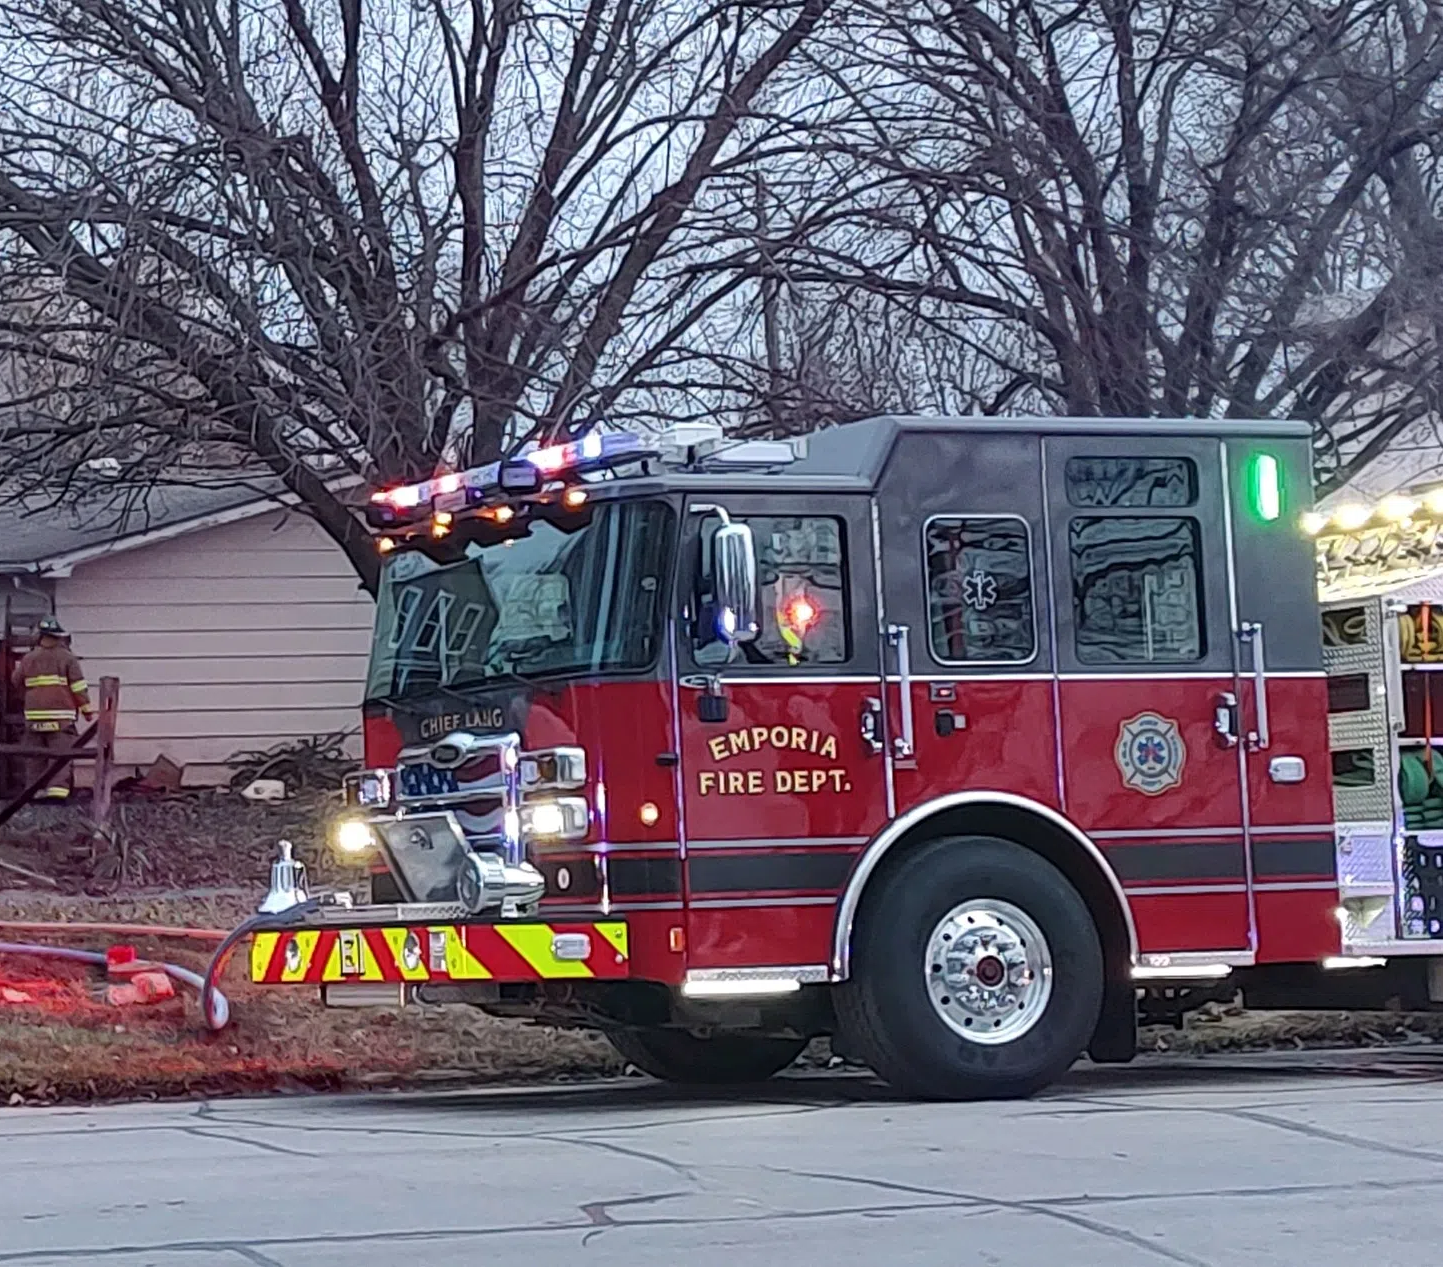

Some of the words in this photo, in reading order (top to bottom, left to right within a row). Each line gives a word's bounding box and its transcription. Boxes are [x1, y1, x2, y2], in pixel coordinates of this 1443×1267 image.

[420, 713, 461, 738] CHIEF
[465, 708, 503, 728] LANG
[708, 726, 837, 760] EMPORIA
[699, 770, 765, 794] FIRE
[775, 769, 851, 792] DEPT.
